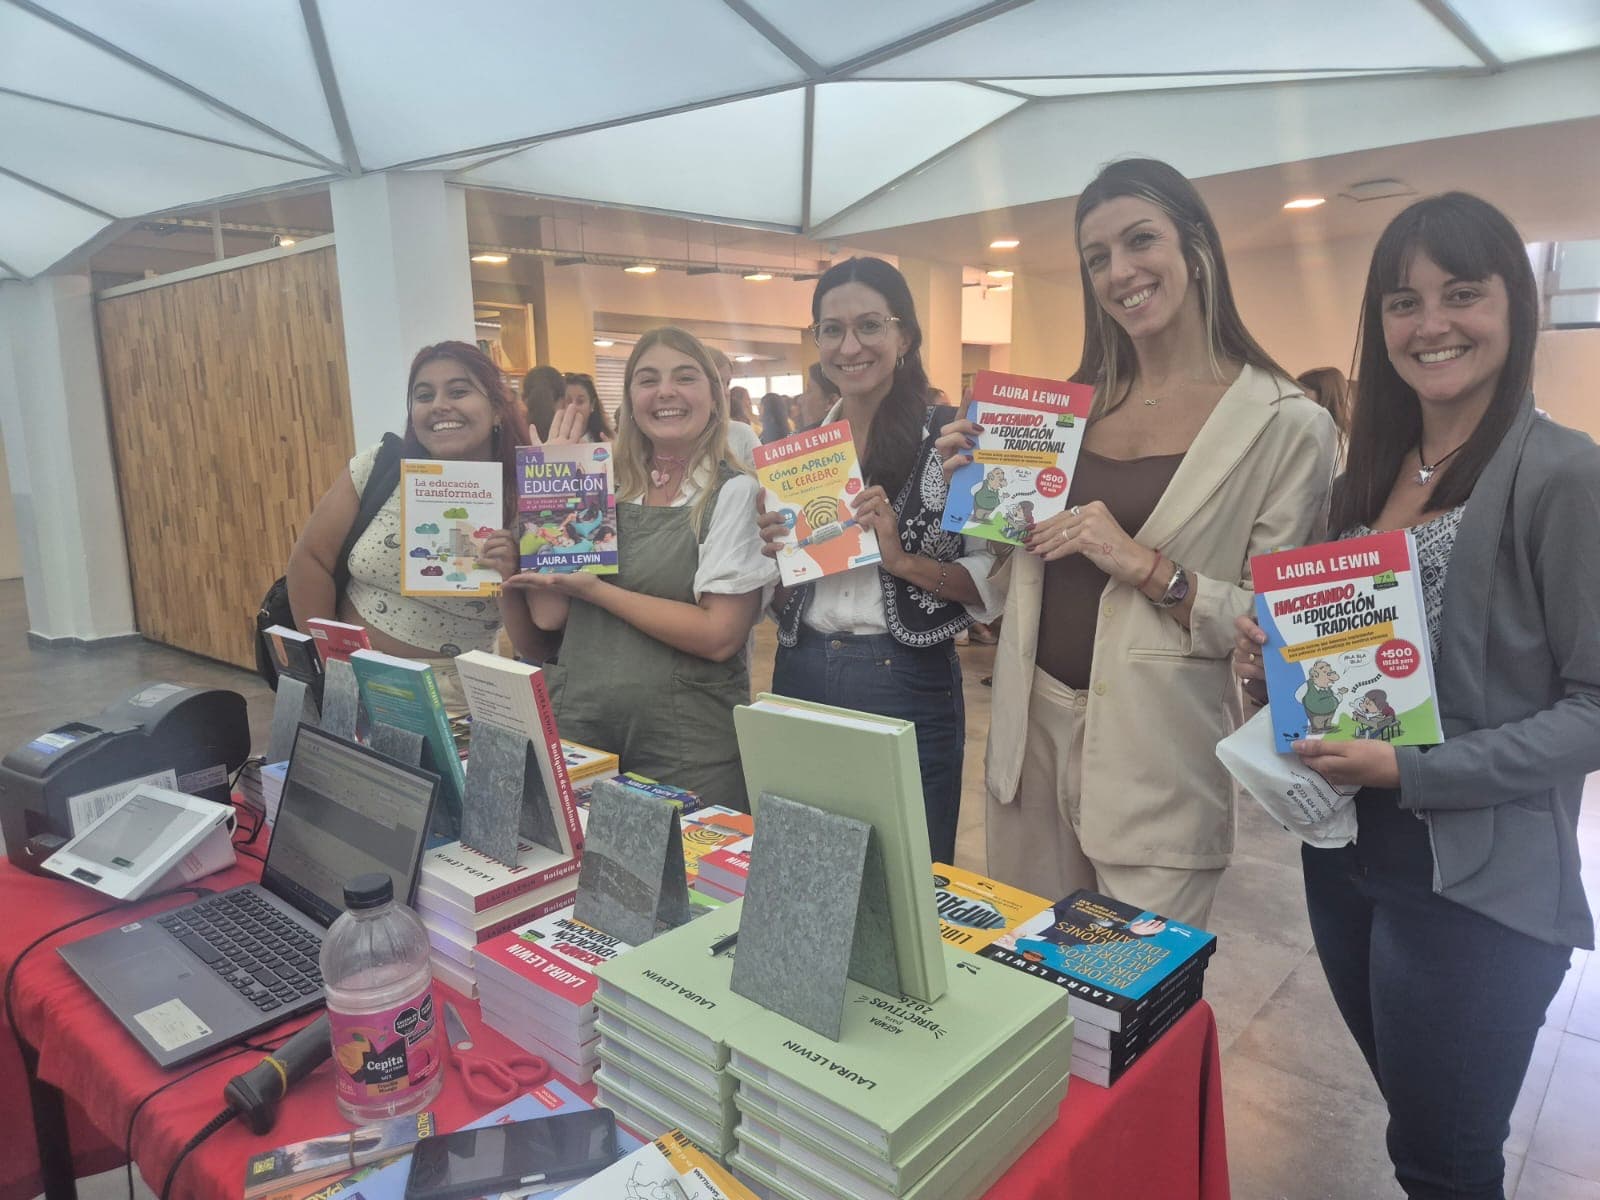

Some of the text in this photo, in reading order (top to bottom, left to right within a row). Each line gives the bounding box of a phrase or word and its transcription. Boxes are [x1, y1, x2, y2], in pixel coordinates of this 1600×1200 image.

[992, 384, 1070, 408] LAURA LEWIN
[980, 412, 1043, 427] HACKEANDO
[990, 423, 1054, 440] LA EDUCACIÓN
[764, 429, 842, 461] LAURA LEWIN
[1003, 438, 1066, 454] TRADICIONAL
[526, 456, 538, 464] LA
[801, 452, 847, 472] APRENDE
[525, 464, 571, 478] NUEVA
[782, 479, 794, 491] EL
[796, 467, 839, 487] CEREBRO
[415, 479, 480, 489] La educación
[415, 488, 492, 500] transformada
[524, 476, 603, 493] EDUCACIÓN
[536, 554, 601, 566] LAURA LEWIN
[1276, 551, 1380, 580] LAURA LEWIN
[1274, 584, 1354, 617] HACKEANDO
[1293, 593, 1375, 624] LA EDUCACIÓN
[1315, 606, 1398, 637] TRADICIONAL
[1381, 648, 1412, 658] +500
[435, 854, 464, 867] LEWIN
[725, 857, 749, 870] WIN
[464, 866, 495, 882] LAURA
[1056, 922, 1162, 966] INSTITUCIONES
[1086, 923, 1171, 958] EDUCATIVAS
[506, 944, 586, 988] LAURA LEWIN
[1083, 944, 1153, 973] MEJORES
[995, 951, 1114, 1002] LAURA LEWIN
[1064, 959, 1132, 990] MEJORES
[642, 970, 716, 1010] LAURA LEWIN
[870, 998, 940, 1031] DIRECTIVOS
[898, 996, 934, 1014] 2026
[870, 1017, 903, 1034] AGENDA
[366, 1056, 404, 1070] Cepita
[782, 1040, 877, 1090] LAURA LEWIN
